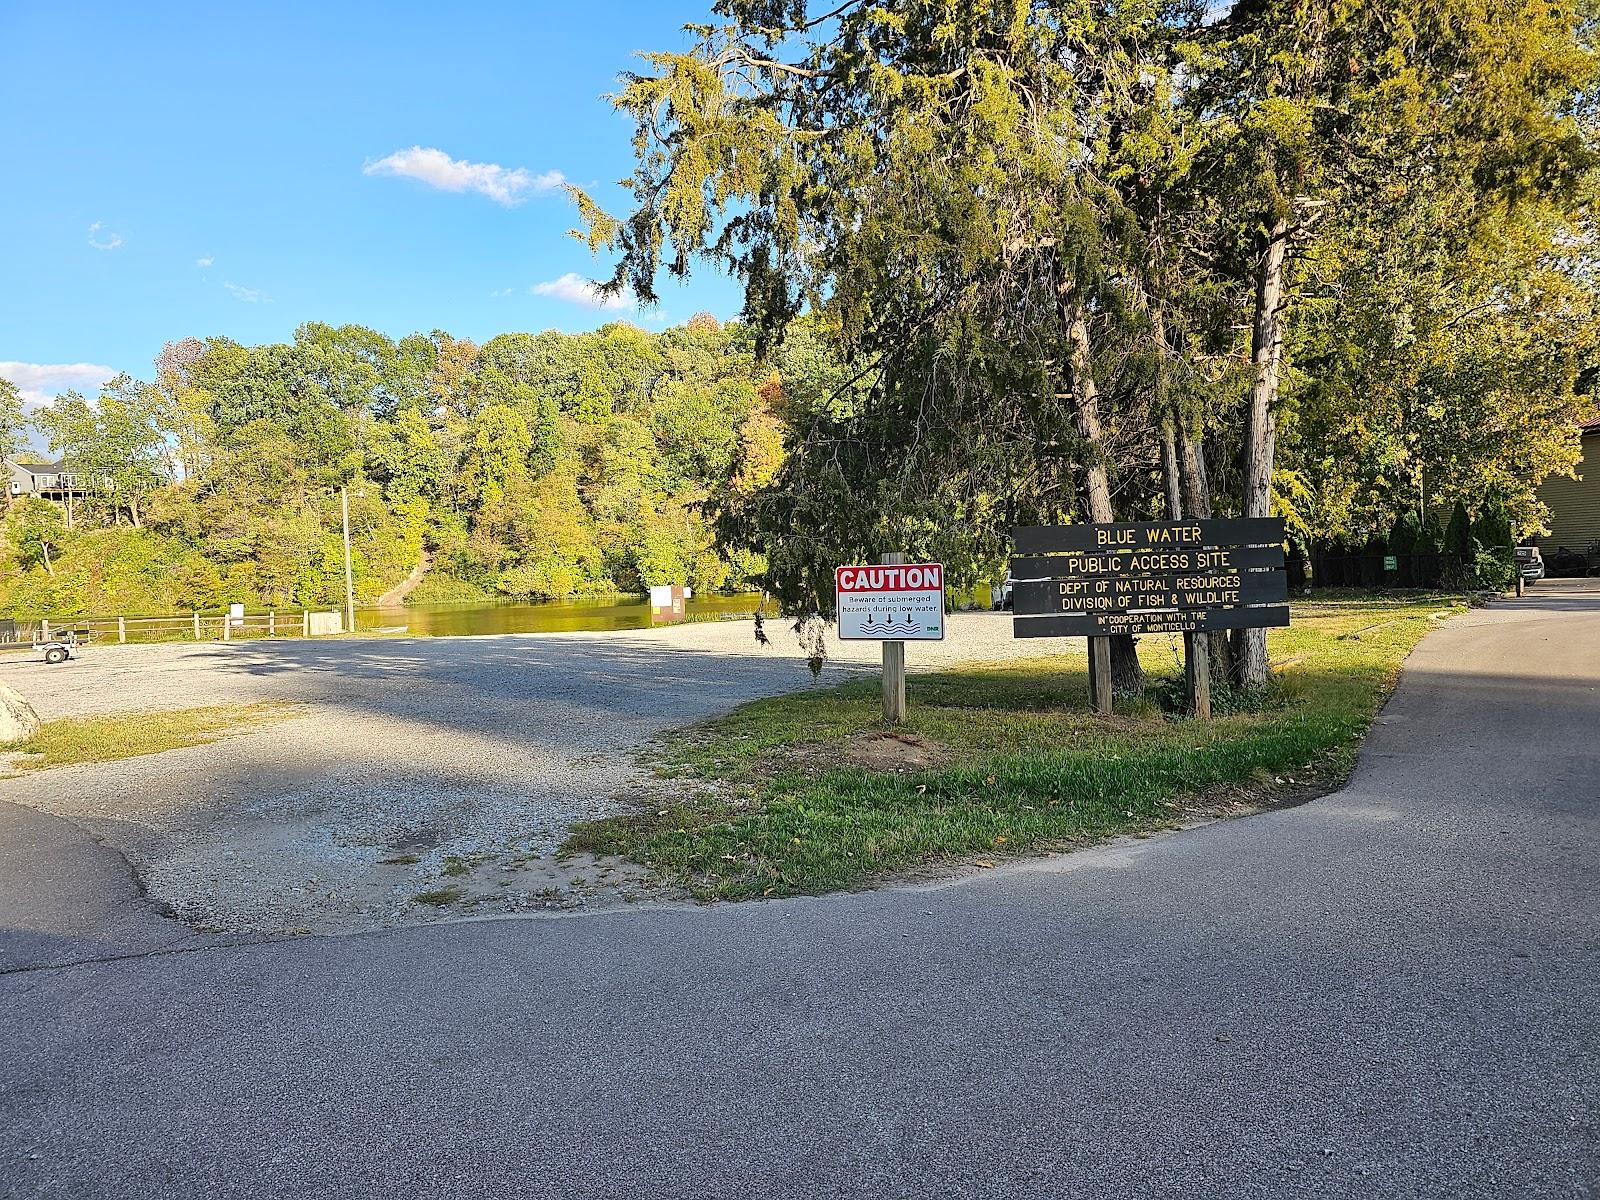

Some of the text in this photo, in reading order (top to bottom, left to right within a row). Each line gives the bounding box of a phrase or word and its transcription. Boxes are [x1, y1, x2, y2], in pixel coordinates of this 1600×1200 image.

[1097, 527, 1202, 545] BLUE WATER
[1068, 552, 1230, 573] PUBLIC ACCESS SITE
[840, 568, 939, 590] CAUTION
[1060, 576, 1240, 594] DEPT OF NATURAL RESOURCES
[888, 595, 930, 604] submerged
[1062, 591, 1240, 610] DIVISION OF FISH & WILDLIFE
[1098, 612, 1207, 624] IN COOPERATION WITH THE
[1110, 622, 1196, 633] CITY OF MONTICELLO
